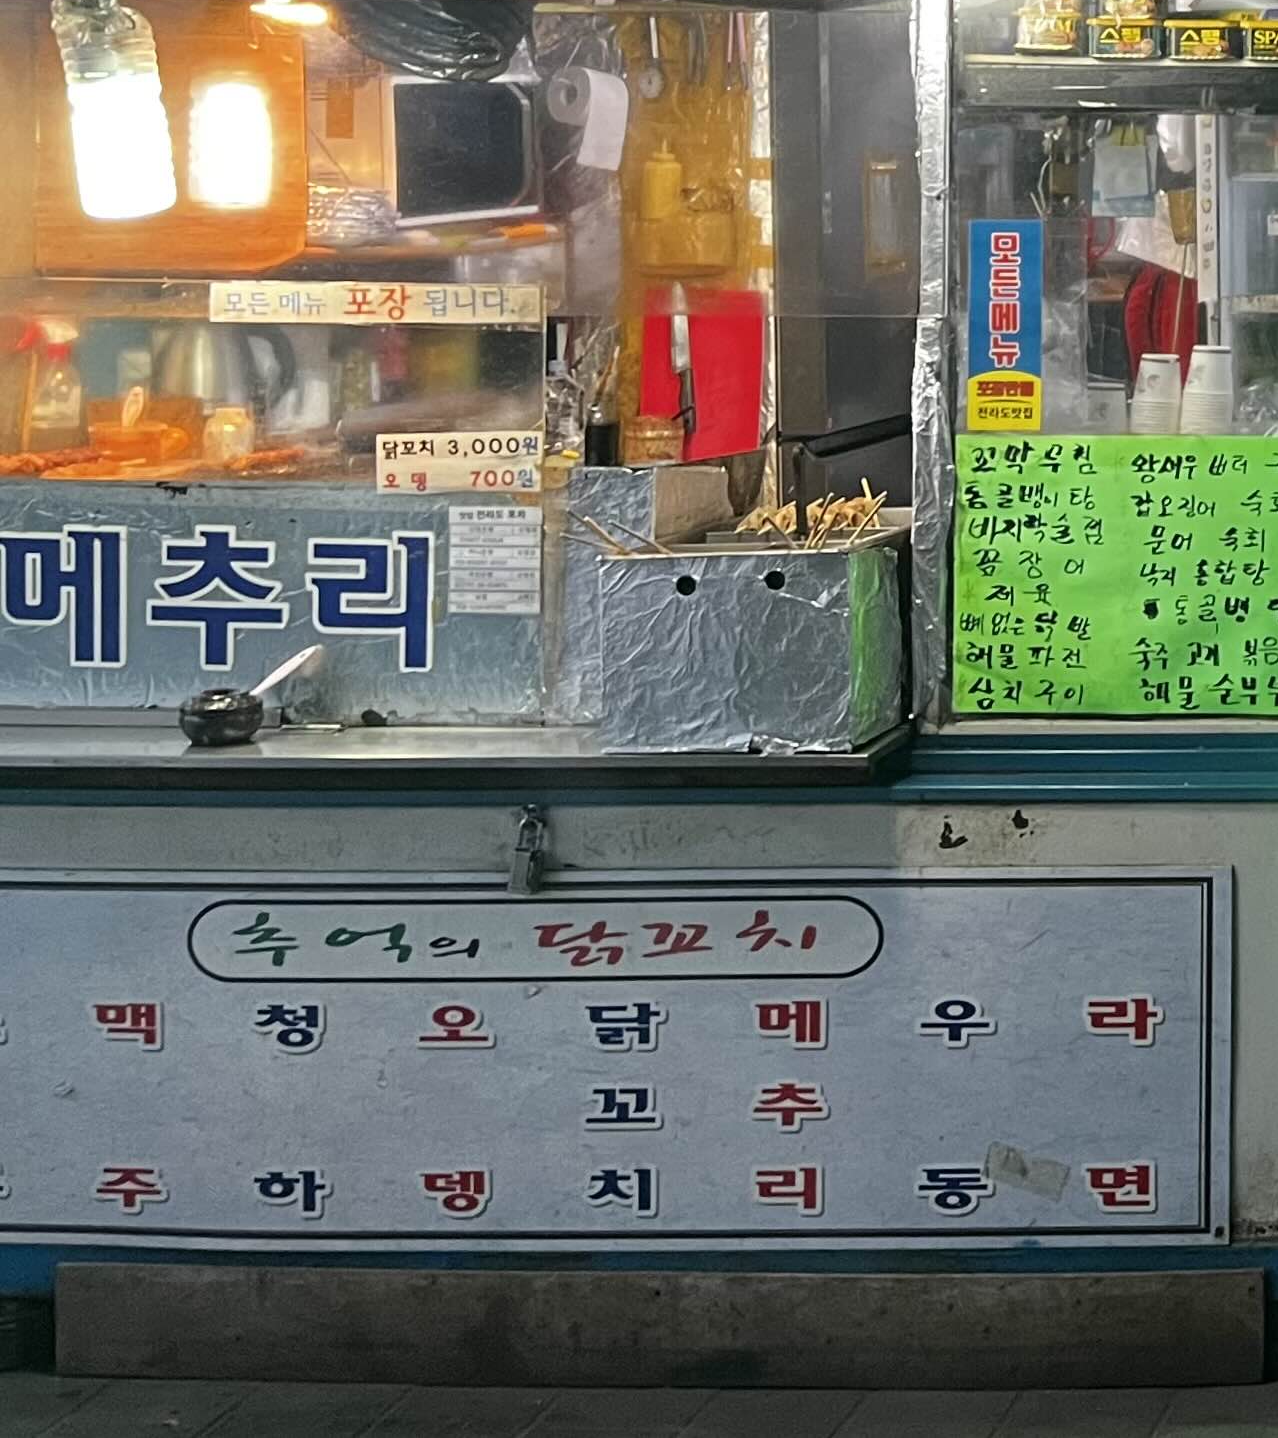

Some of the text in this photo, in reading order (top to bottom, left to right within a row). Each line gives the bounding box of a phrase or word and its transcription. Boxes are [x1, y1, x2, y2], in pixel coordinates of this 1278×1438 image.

[223, 291, 270, 315] 모든
[278, 292, 326, 317] 메뉴
[343, 285, 412, 321] 포장
[382, 435, 539, 460] 닭꼬치 3,000원
[469, 468, 535, 490] 700원
[0, 524, 435, 671] 메추리
[233, 910, 817, 966] 추억의 닭꼬치
